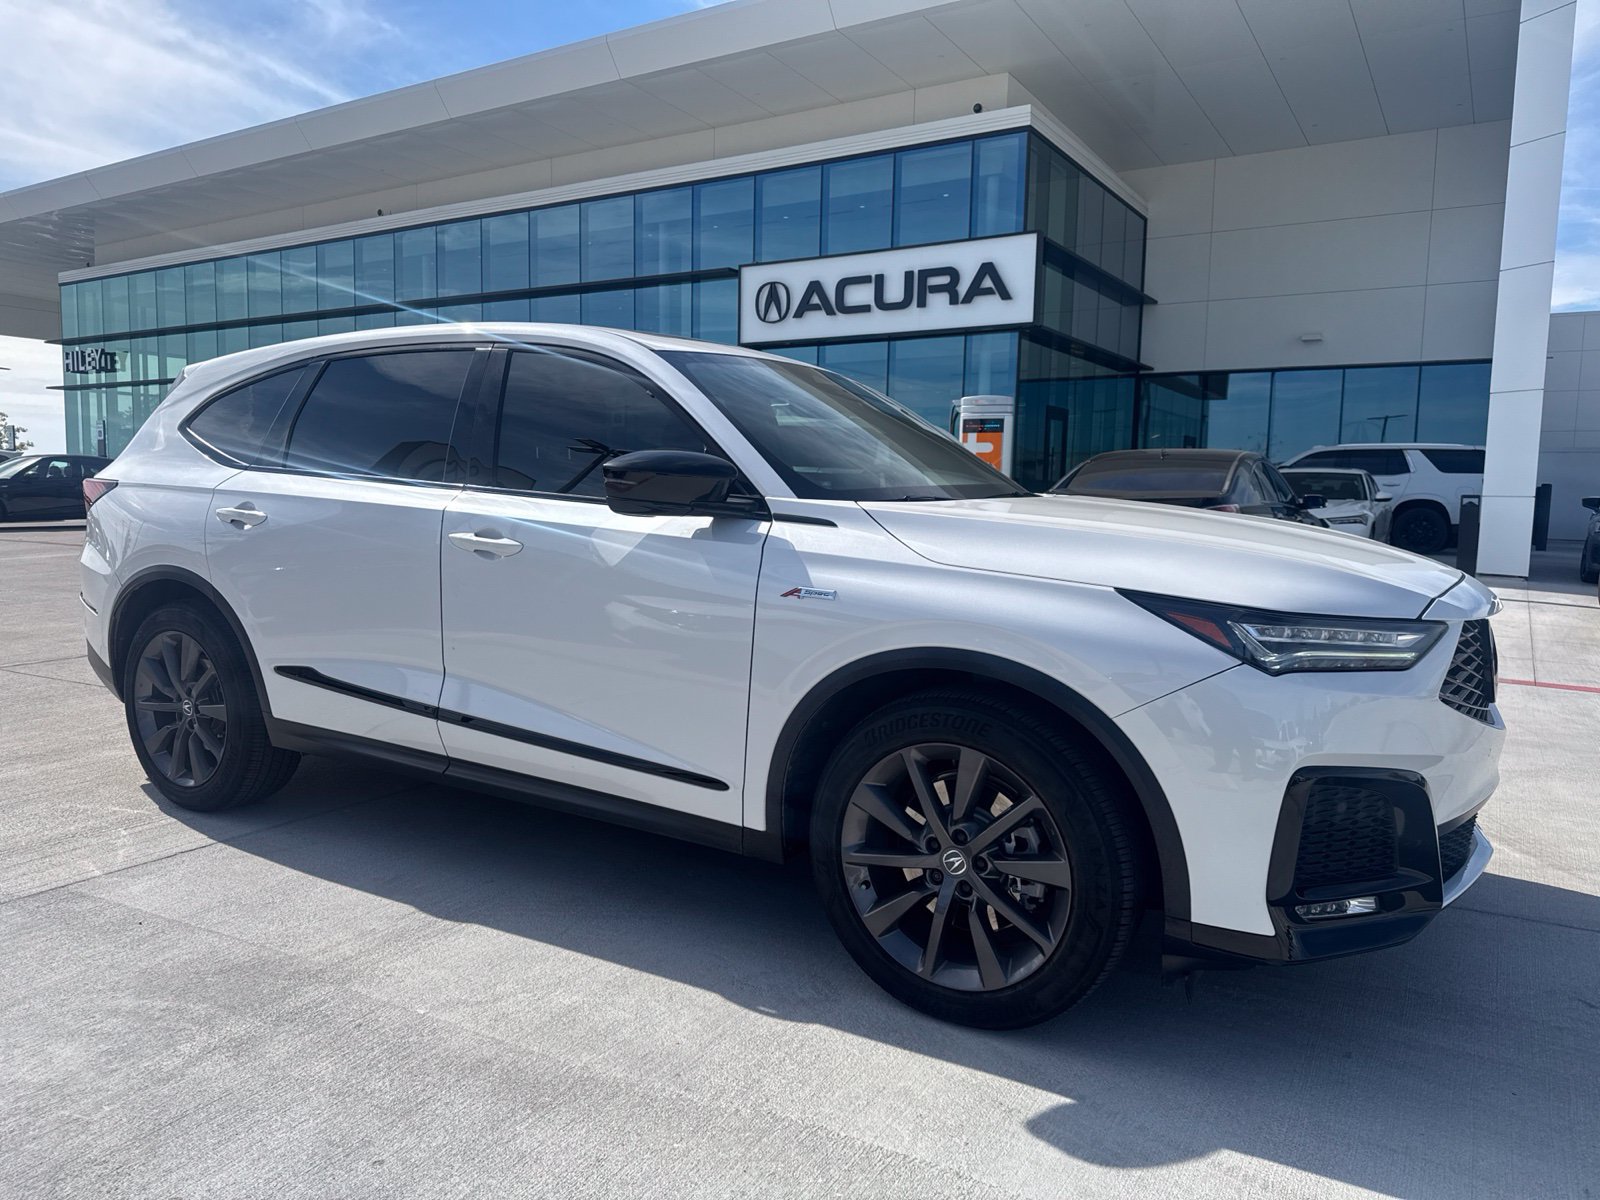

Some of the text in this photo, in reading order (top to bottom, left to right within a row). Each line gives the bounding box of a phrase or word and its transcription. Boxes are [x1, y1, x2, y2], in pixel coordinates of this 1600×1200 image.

[792, 261, 1013, 318] ACURA
[64, 348, 102, 372] HILEY
[864, 712, 993, 746] BRIDGESTONE
